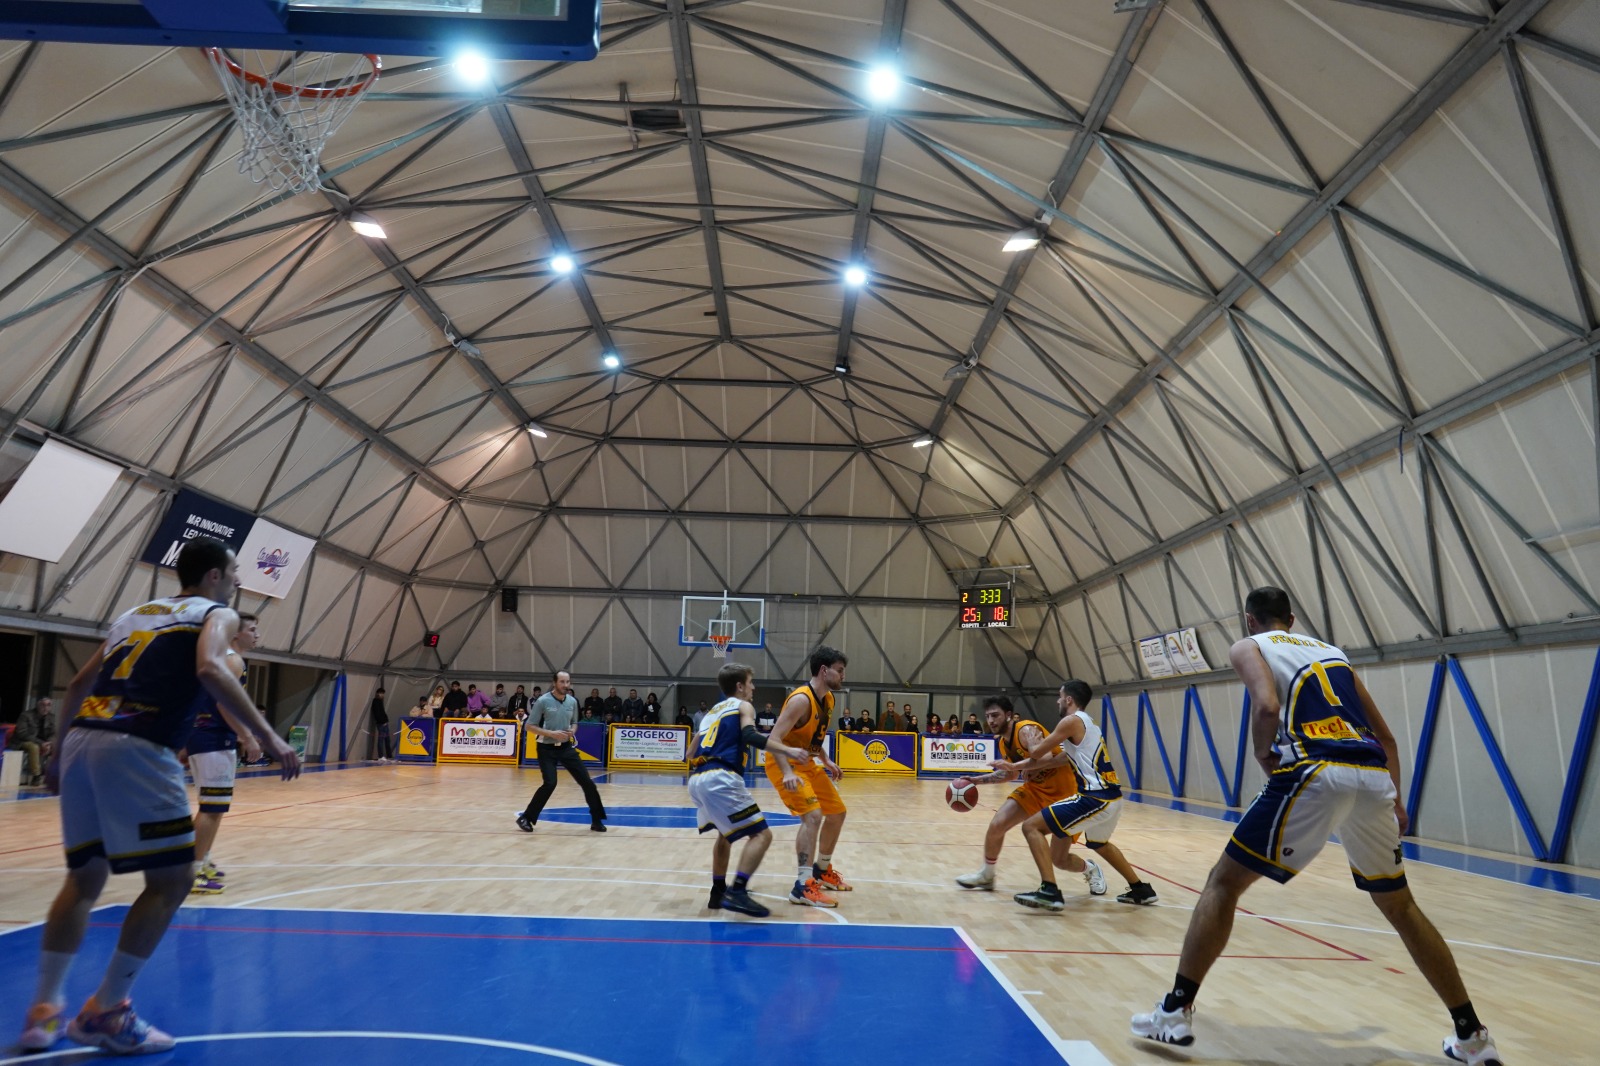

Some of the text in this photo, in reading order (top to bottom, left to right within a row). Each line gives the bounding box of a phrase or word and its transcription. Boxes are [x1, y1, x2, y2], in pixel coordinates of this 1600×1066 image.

[182, 528, 199, 540] LED
[200, 519, 235, 538] INNOVATIVE
[962, 592, 969, 603] 2
[980, 589, 1001, 604] 3:33
[963, 607, 977, 622] 25
[994, 606, 1004, 621] 18
[111, 630, 157, 680] 7
[620, 729, 675, 740] SORGEKO
[450, 737, 507, 747] CAMERETTE
[930, 752, 987, 761] CAMERETTE
